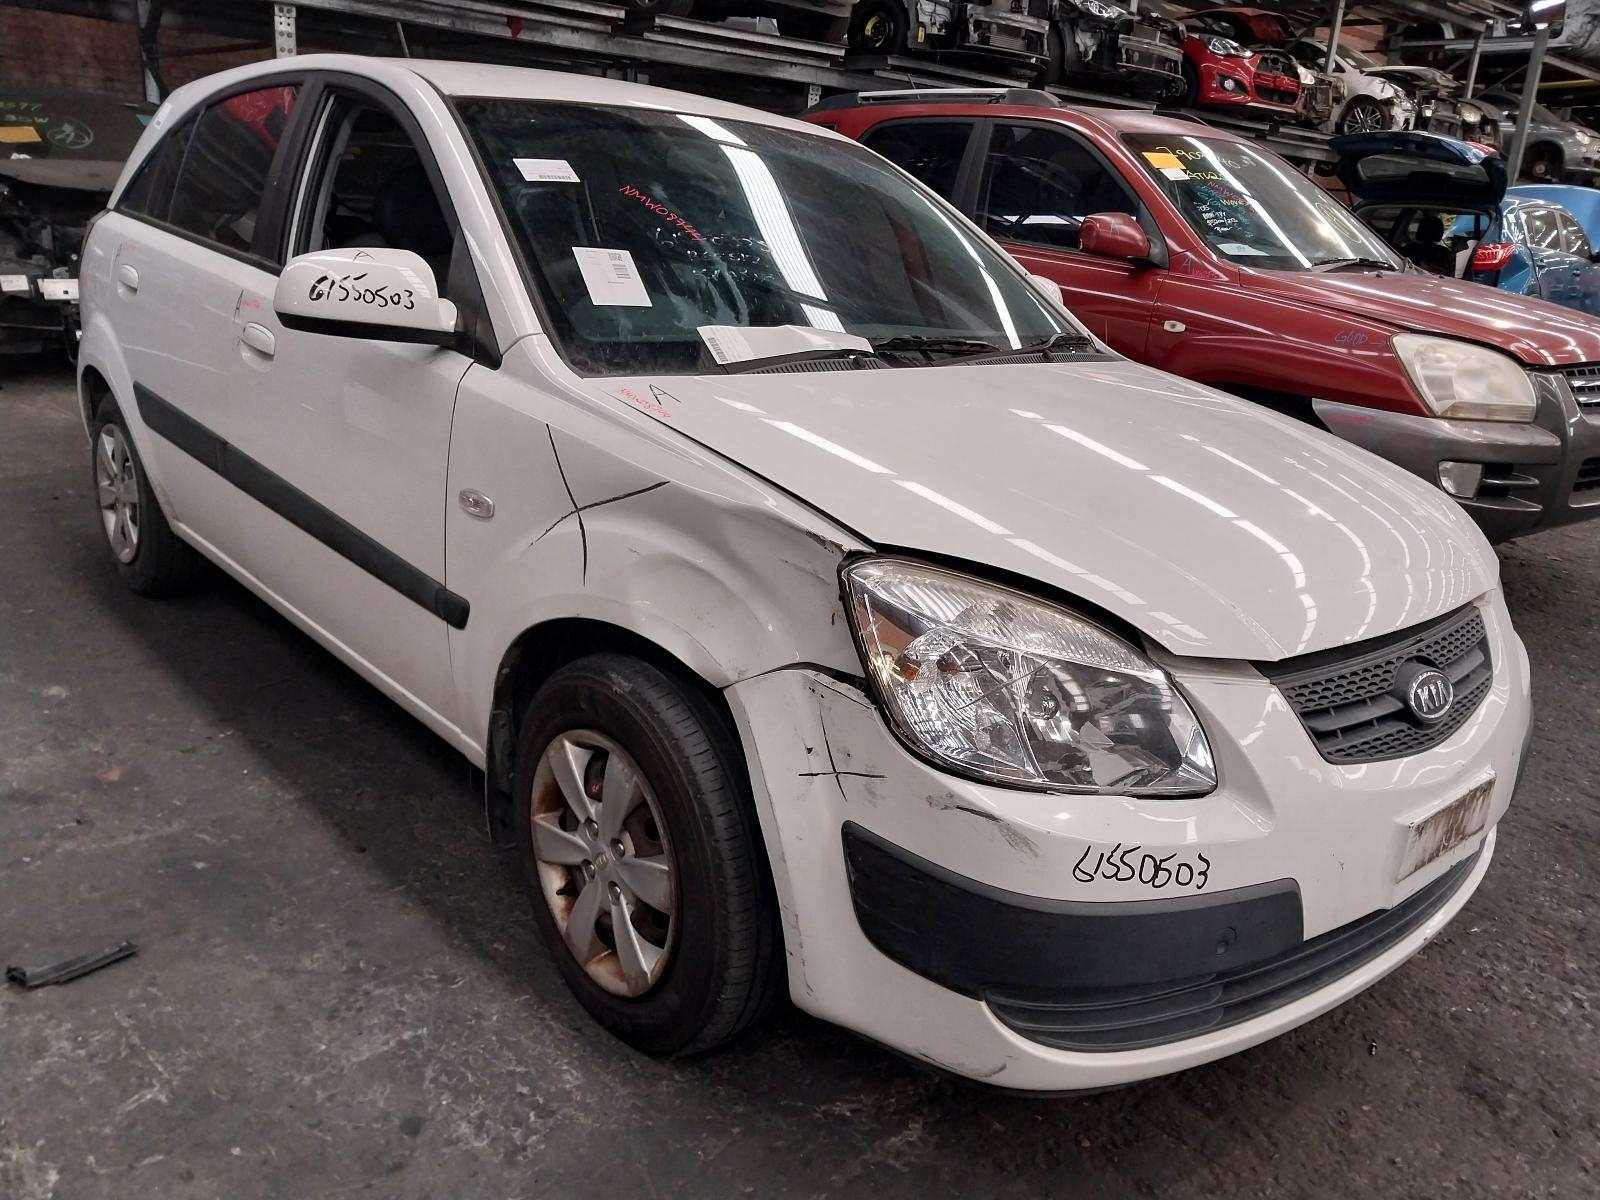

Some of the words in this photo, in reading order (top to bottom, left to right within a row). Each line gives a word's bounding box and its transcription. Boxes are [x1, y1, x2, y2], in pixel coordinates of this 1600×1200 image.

[308, 272, 415, 310] 61550503
[648, 384, 682, 406] A
[1416, 680, 1450, 712] KIA
[1072, 842, 1211, 889] 61550503
